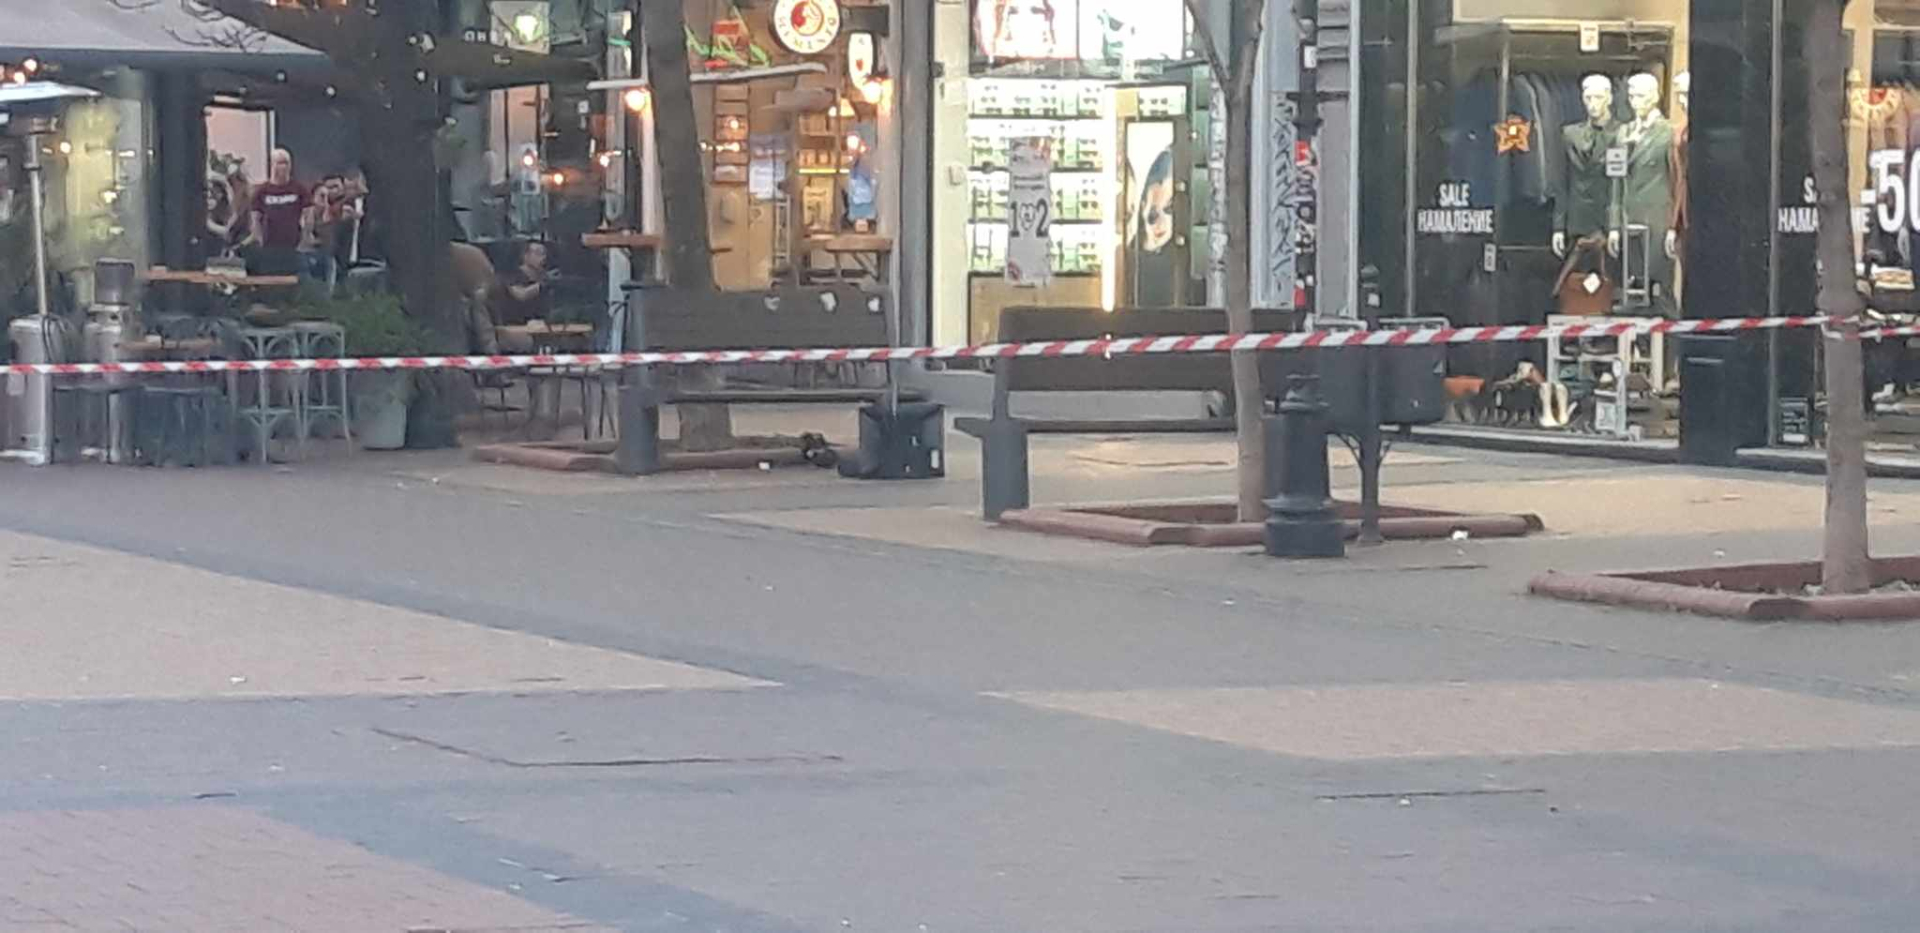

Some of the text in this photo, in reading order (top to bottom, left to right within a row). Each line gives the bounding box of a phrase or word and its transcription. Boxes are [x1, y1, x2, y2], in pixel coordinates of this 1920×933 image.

[1439, 183, 1470, 207] SALE
[1036, 197, 1049, 238] 2
[1418, 208, 1494, 233] НАМАЛЕНИЕ
